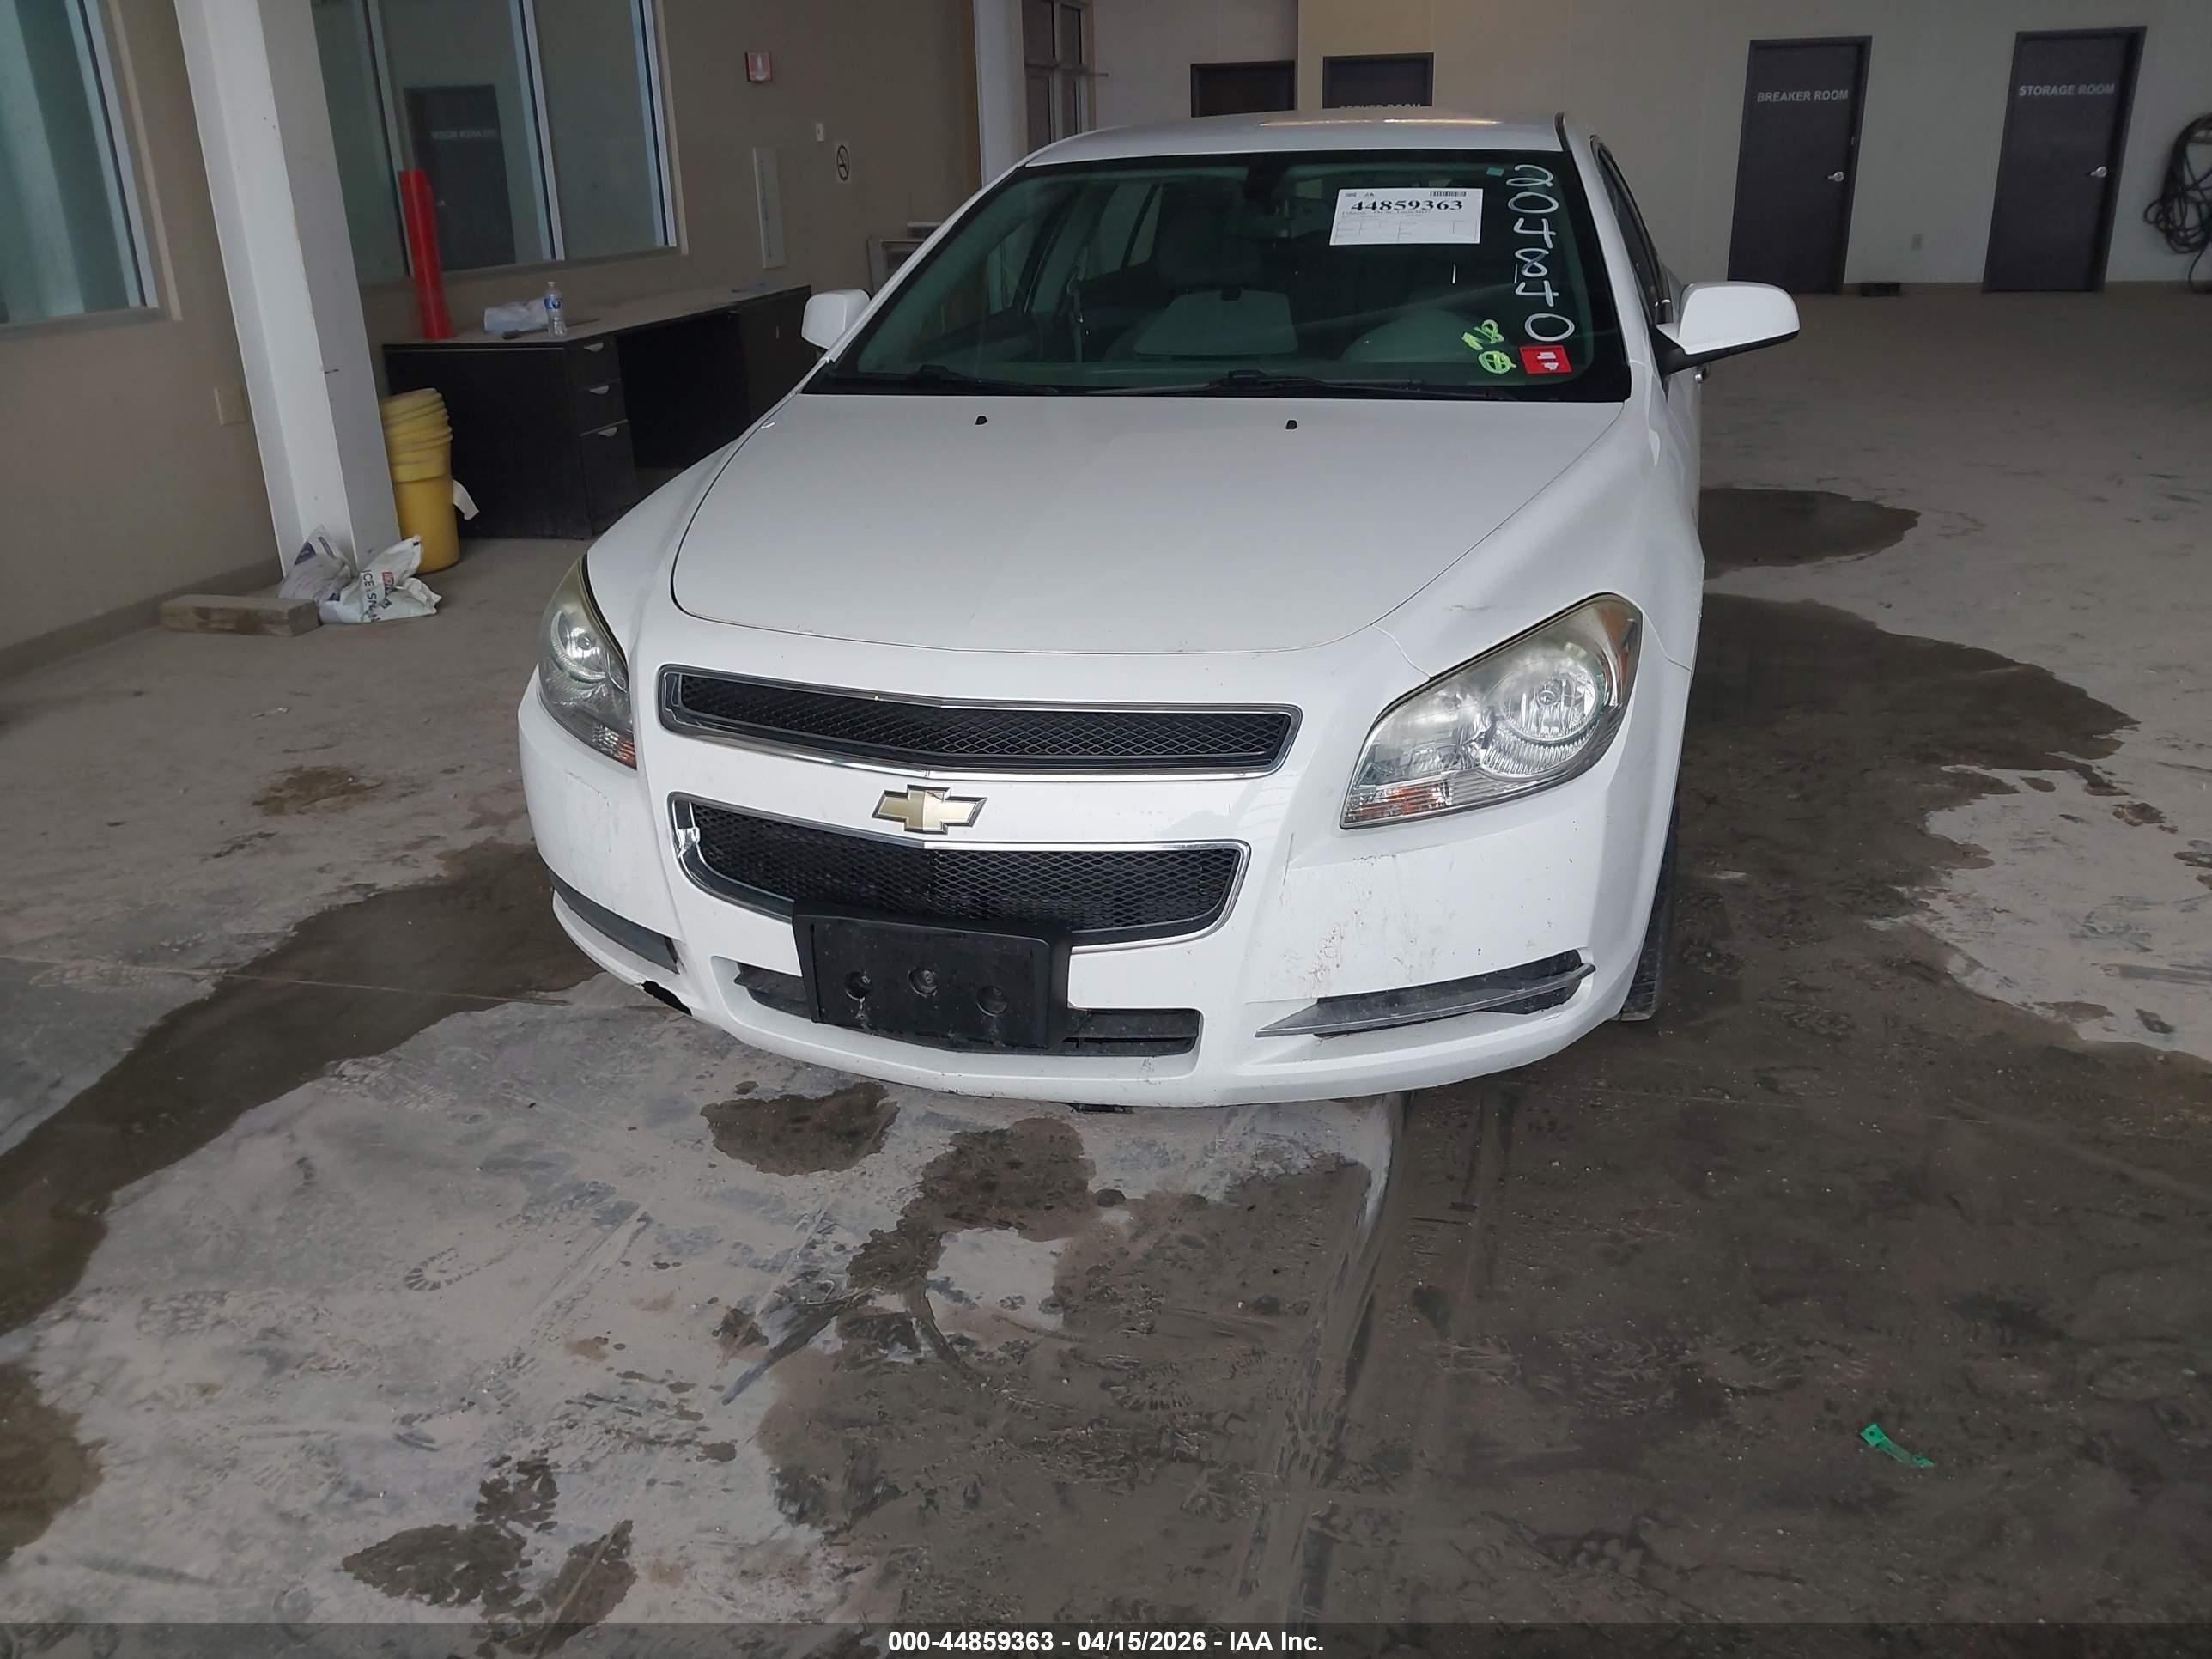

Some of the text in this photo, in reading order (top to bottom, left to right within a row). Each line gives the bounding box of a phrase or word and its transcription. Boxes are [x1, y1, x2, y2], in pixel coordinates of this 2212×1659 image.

[1757, 89, 1849, 102] BREAKER ROOM
[2019, 83, 2115, 97] STORAGE ROOM
[1351, 199, 1463, 211] 44859363
